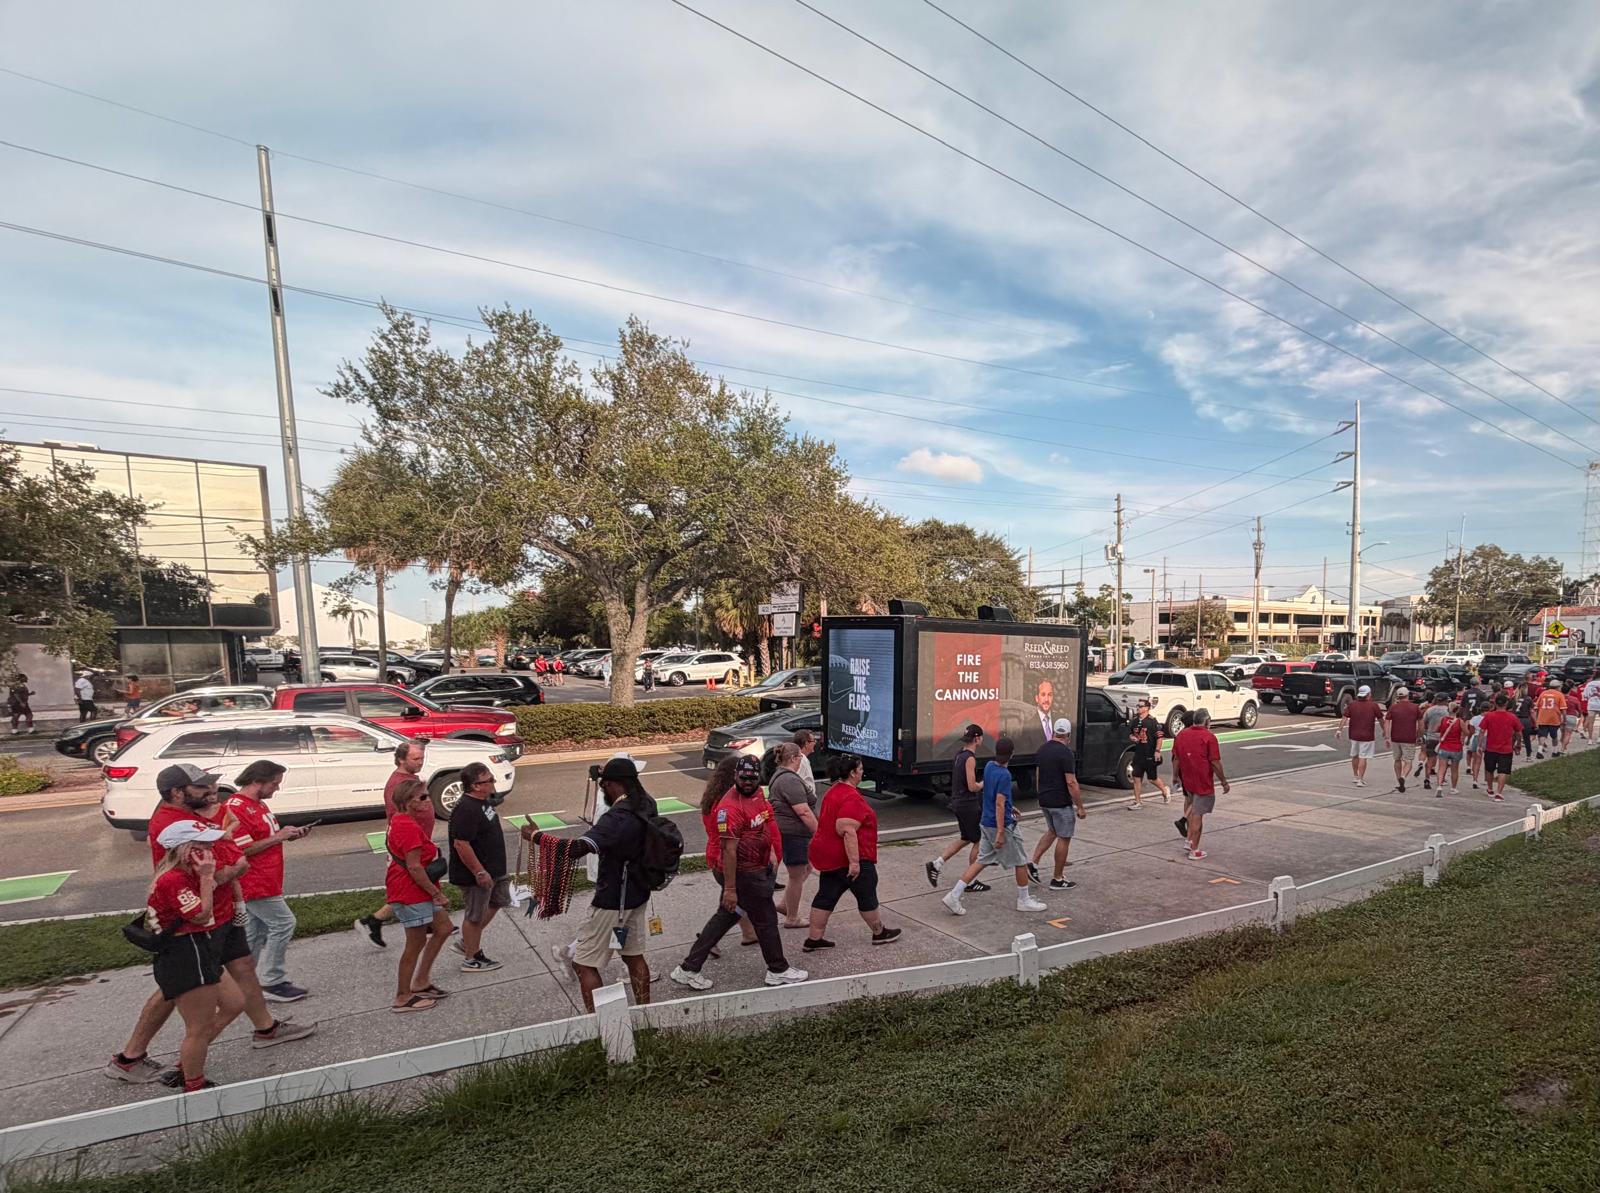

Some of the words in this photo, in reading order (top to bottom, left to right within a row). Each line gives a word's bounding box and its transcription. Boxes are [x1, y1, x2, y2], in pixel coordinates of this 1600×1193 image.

[956, 654, 982, 666] FIRE
[850, 658, 871, 676] RAISE
[957, 671, 980, 683] THE
[853, 676, 867, 693] THE
[934, 688, 1000, 701] CANNONS!
[848, 693, 871, 712] FLAGS
[1469, 699, 1477, 711] 7
[1541, 697, 1555, 709] 13
